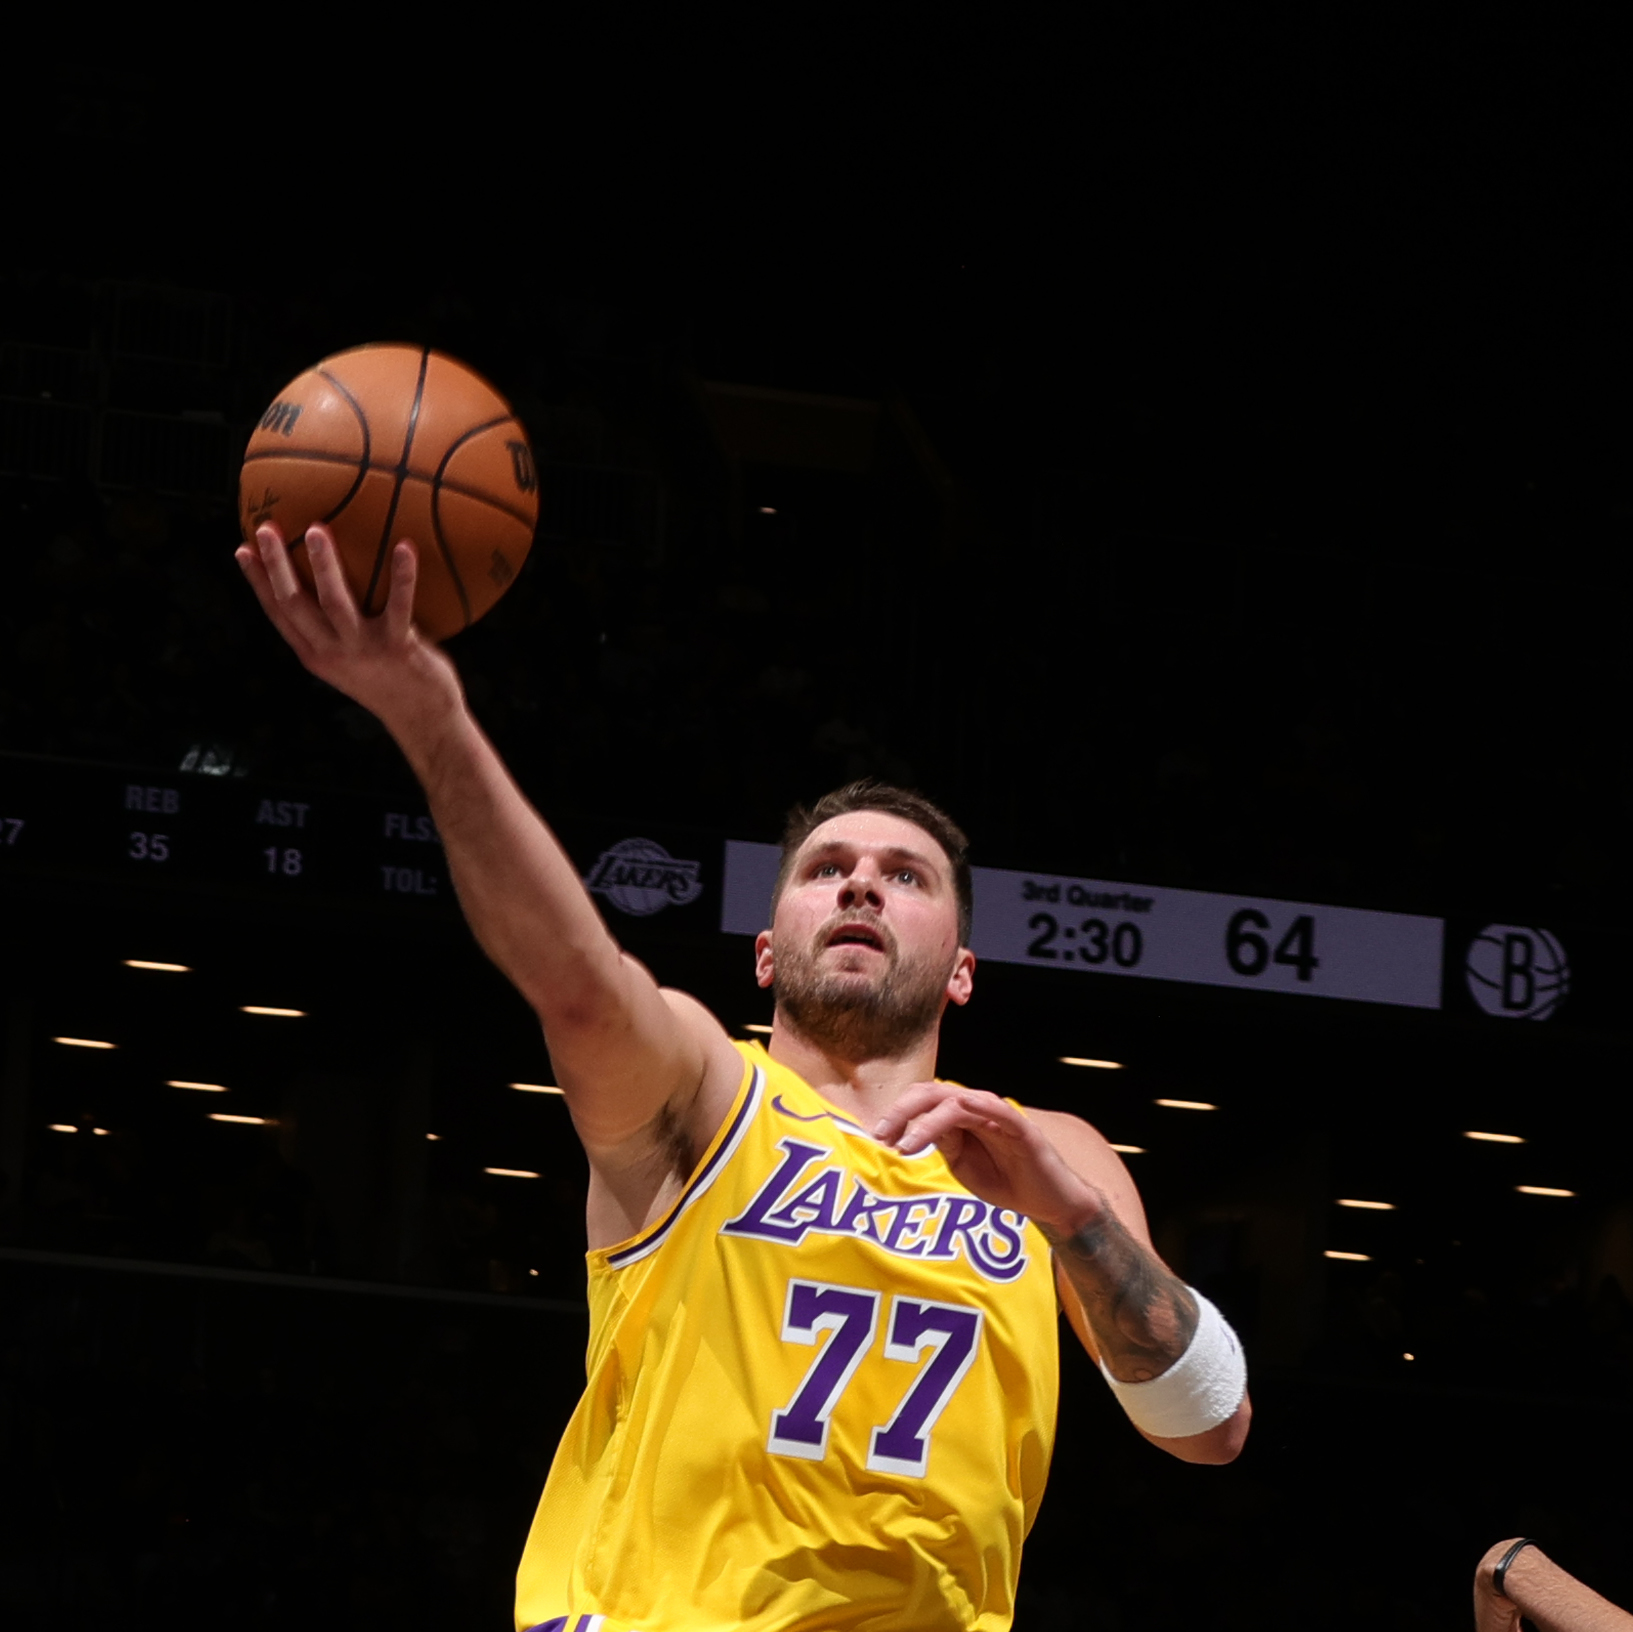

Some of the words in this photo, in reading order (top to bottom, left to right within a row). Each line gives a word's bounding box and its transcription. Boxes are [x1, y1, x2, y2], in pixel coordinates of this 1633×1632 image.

[123, 783, 181, 815] REB
[255, 799, 310, 829] AST
[128, 831, 170, 862] 35
[263, 845, 304, 877] 18
[380, 864, 438, 896] TOL:
[1023, 880, 1060, 903] 3rd
[1069, 885, 1155, 912] Quarter
[1027, 913, 1142, 967] 2:30
[1226, 908, 1318, 981] 64
[719, 1136, 1028, 1283] LAKERS
[768, 1277, 986, 1479] 77
